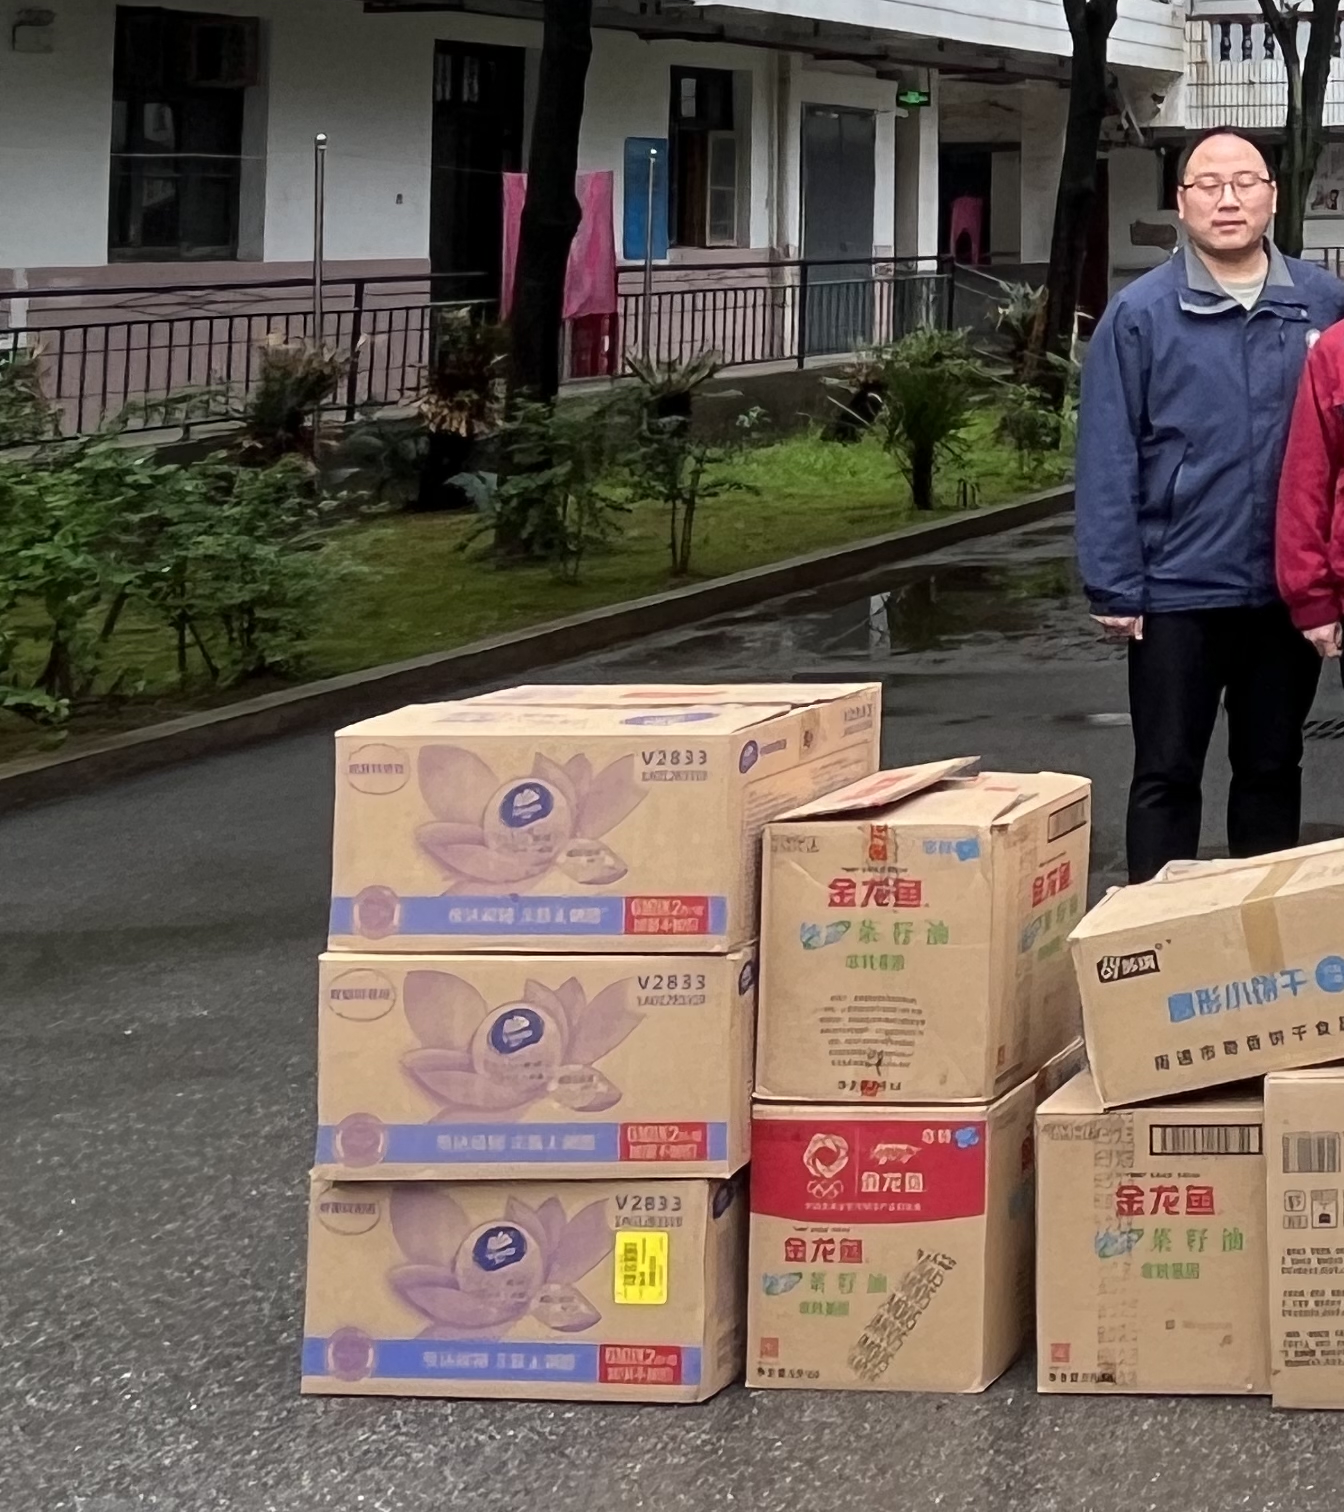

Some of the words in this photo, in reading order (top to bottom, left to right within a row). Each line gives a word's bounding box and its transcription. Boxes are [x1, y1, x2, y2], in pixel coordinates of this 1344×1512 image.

[641, 750, 708, 766] V2833
[828, 877, 923, 908] 金龙鱼
[637, 974, 706, 991] V2833
[615, 1194, 682, 1212] V2833
[1115, 1184, 1216, 1216] 金龙鱼
